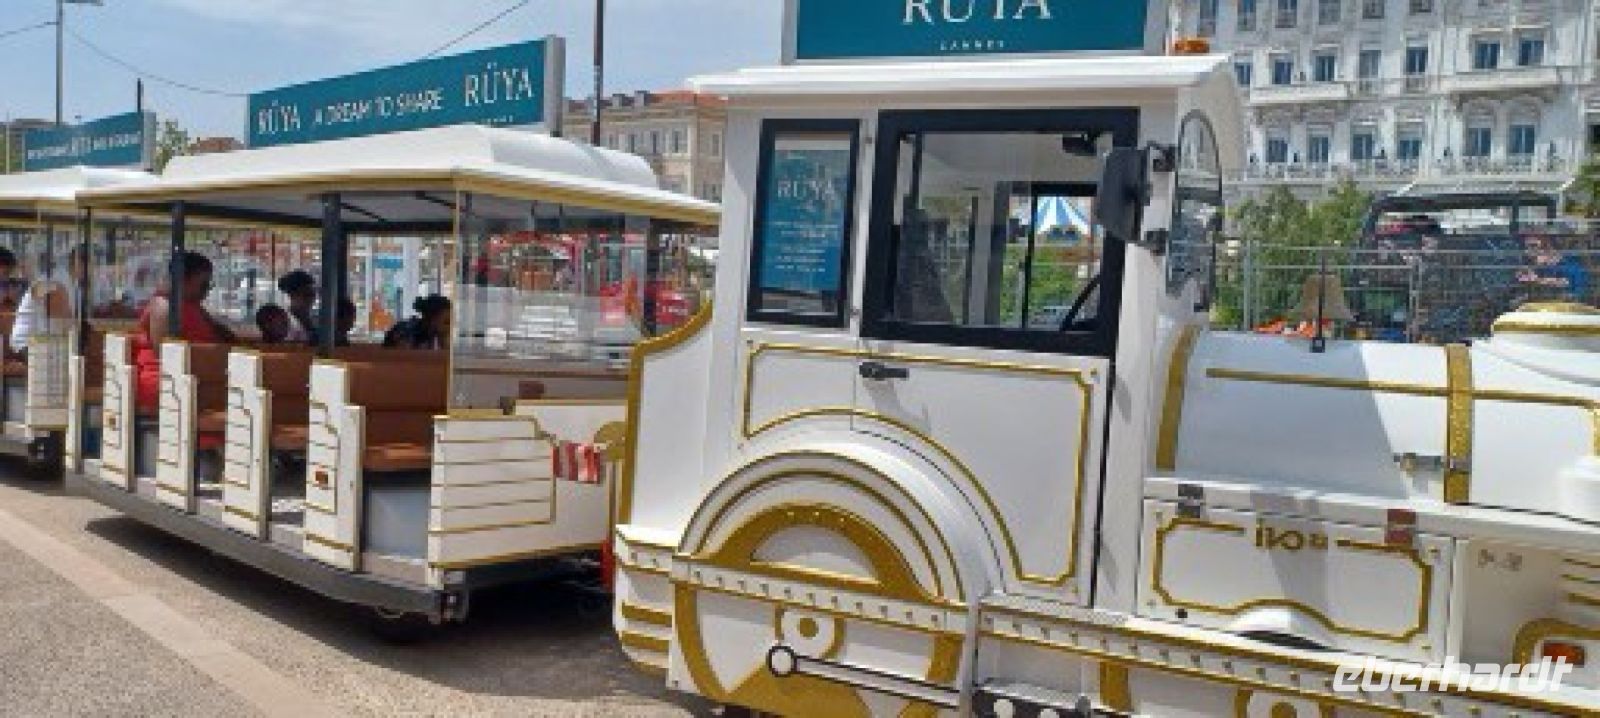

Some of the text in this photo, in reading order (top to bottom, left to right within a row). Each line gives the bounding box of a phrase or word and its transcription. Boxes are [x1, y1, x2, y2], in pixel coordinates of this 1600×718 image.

[258, 99, 301, 135] RÜYA
[325, 99, 373, 125] DREAM
[374, 95, 394, 118] TO
[396, 87, 444, 116] SHARE
[465, 62, 535, 107] RÜYA
